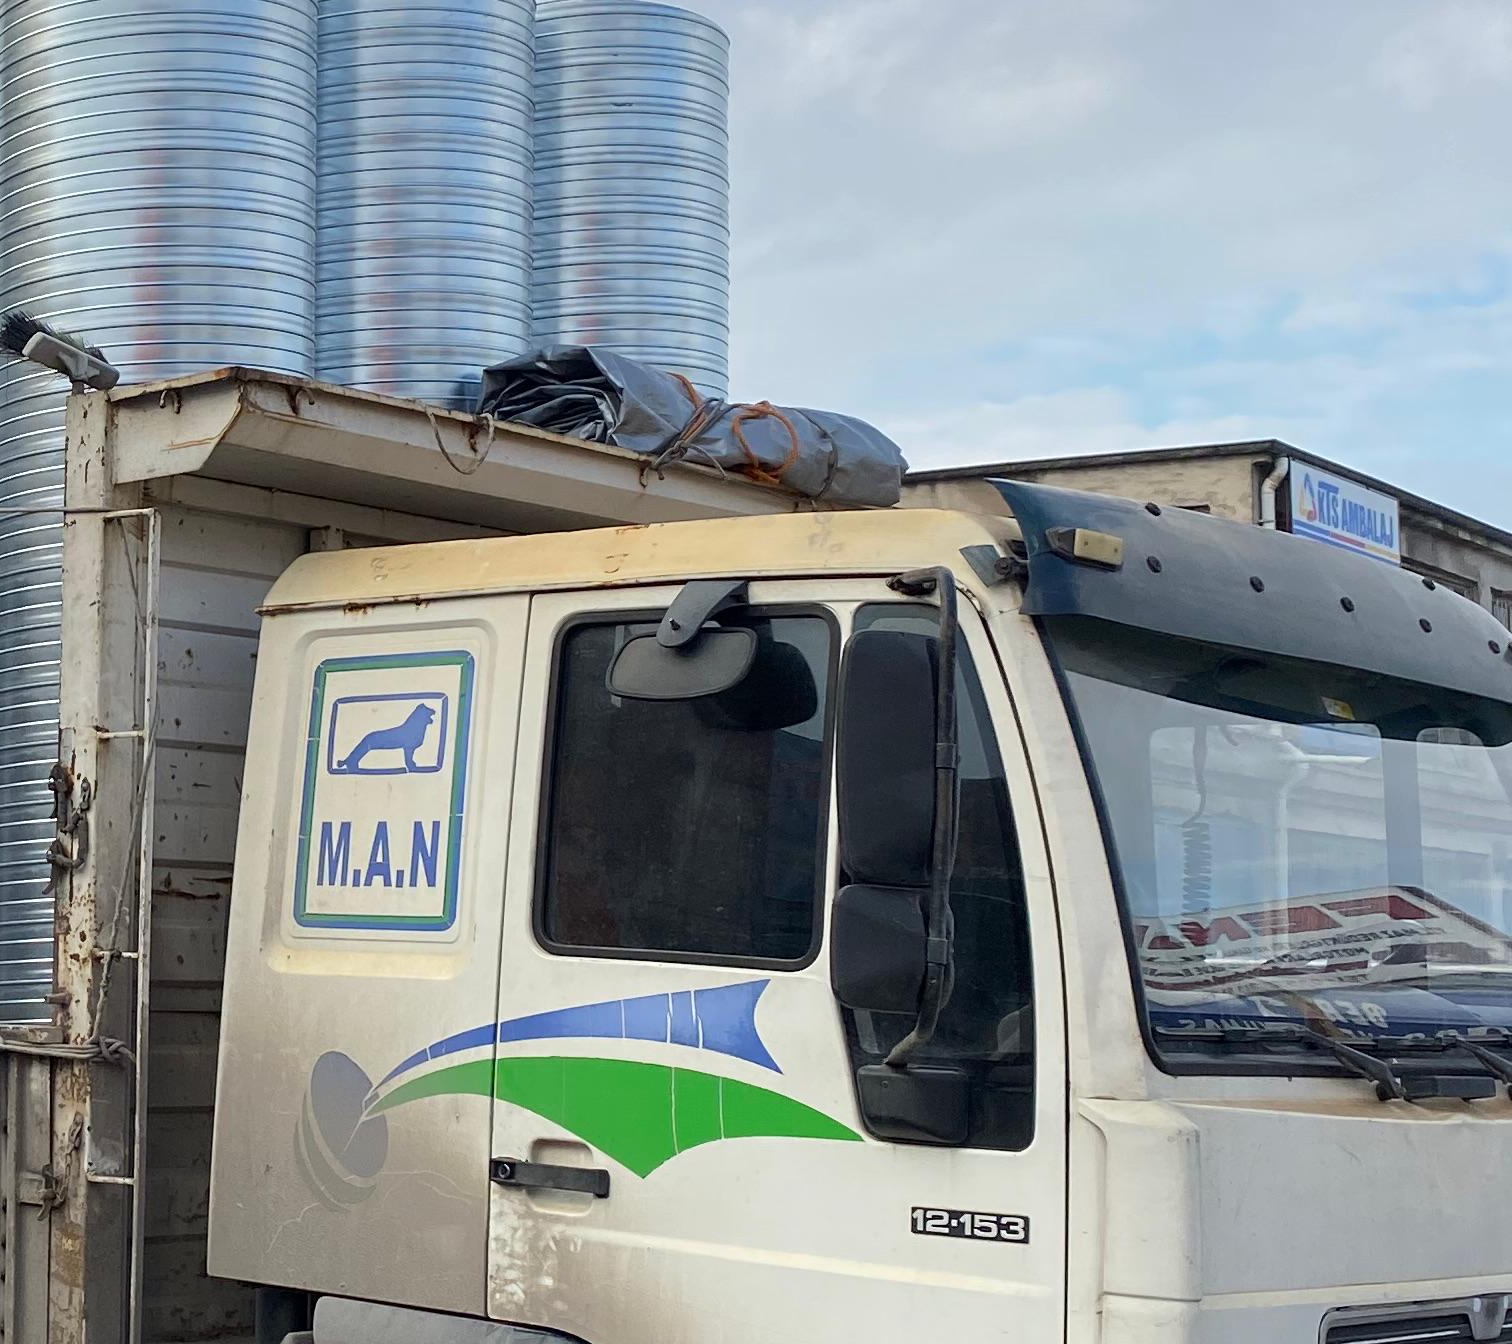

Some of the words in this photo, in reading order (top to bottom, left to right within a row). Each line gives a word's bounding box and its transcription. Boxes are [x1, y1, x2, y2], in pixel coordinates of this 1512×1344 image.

[1317, 480, 1339, 529] KTS
[1341, 498, 1393, 548] AMBALAJ
[316, 821, 440, 888] M.A.N
